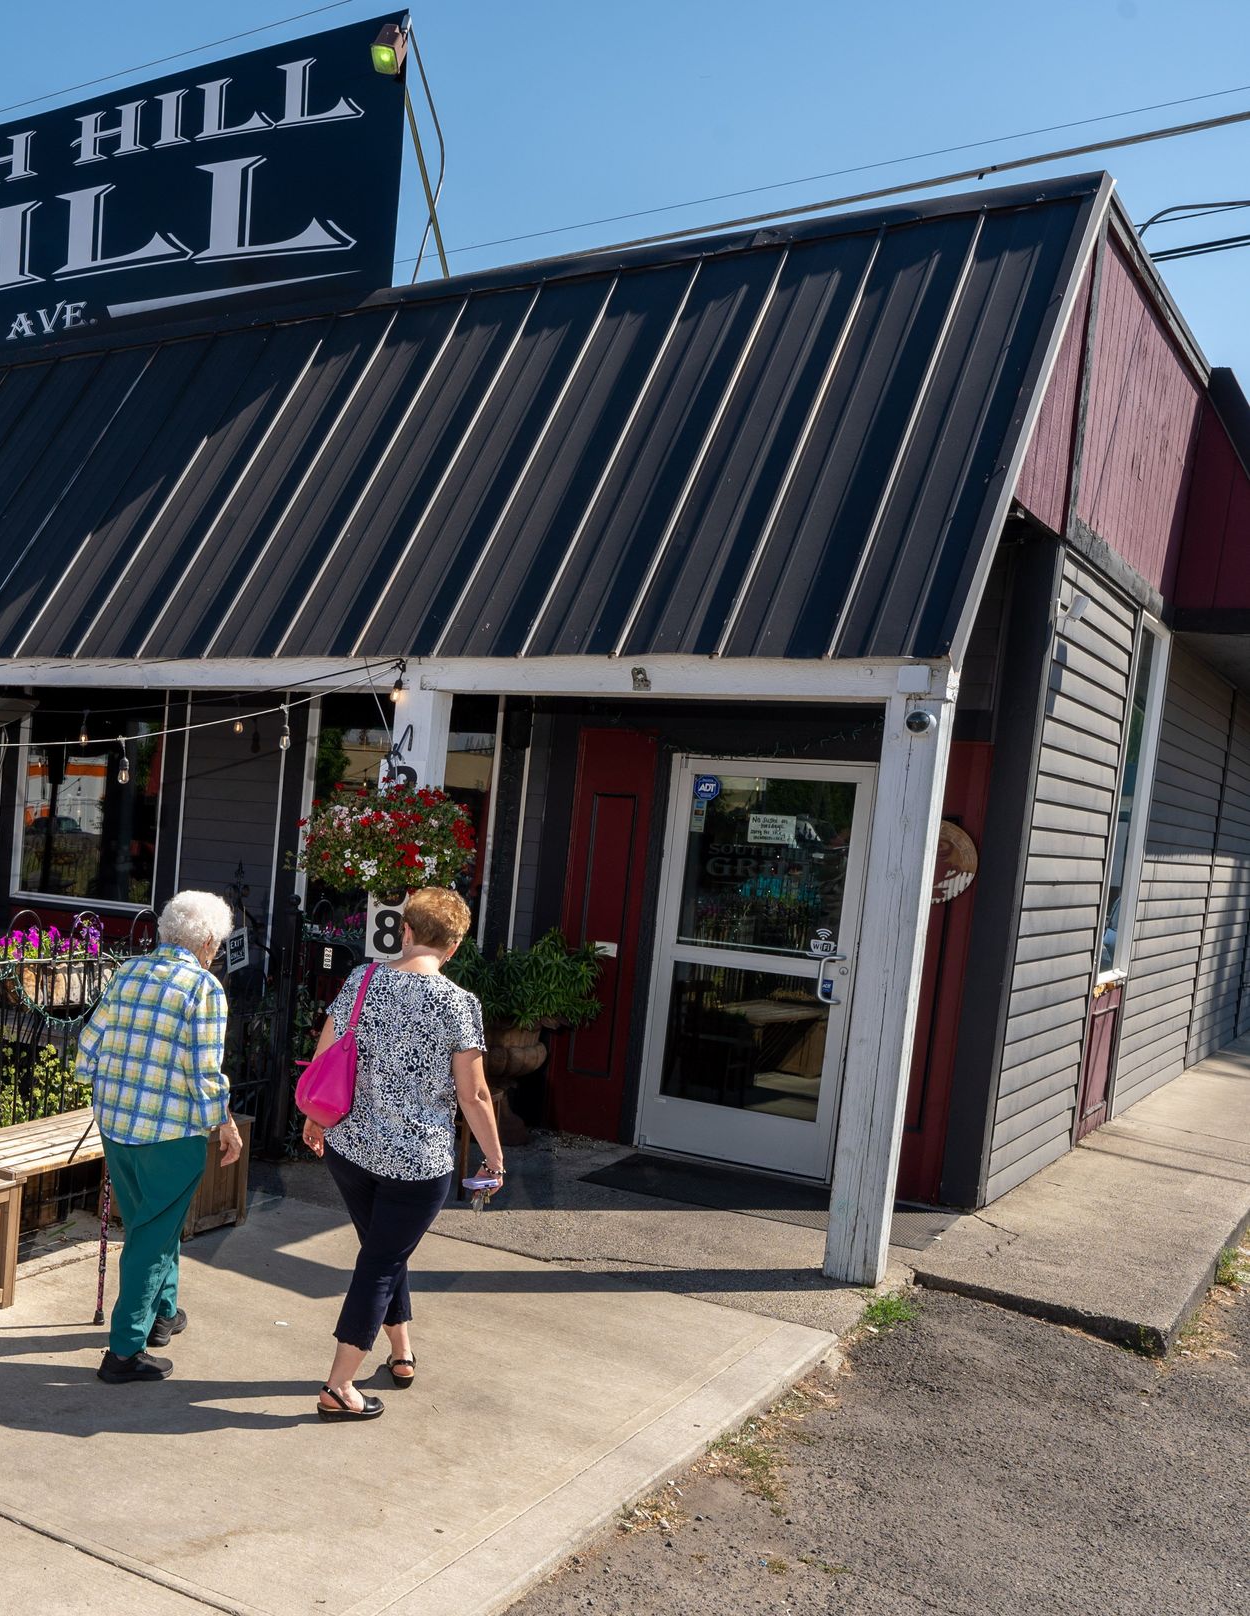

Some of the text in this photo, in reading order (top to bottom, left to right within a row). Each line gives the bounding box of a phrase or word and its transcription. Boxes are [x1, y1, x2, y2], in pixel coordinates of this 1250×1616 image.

[71, 57, 365, 166] HILL
[5, 299, 98, 341] AVE.
[698, 783, 716, 793] ADT
[324, 948, 332, 968] 2808
